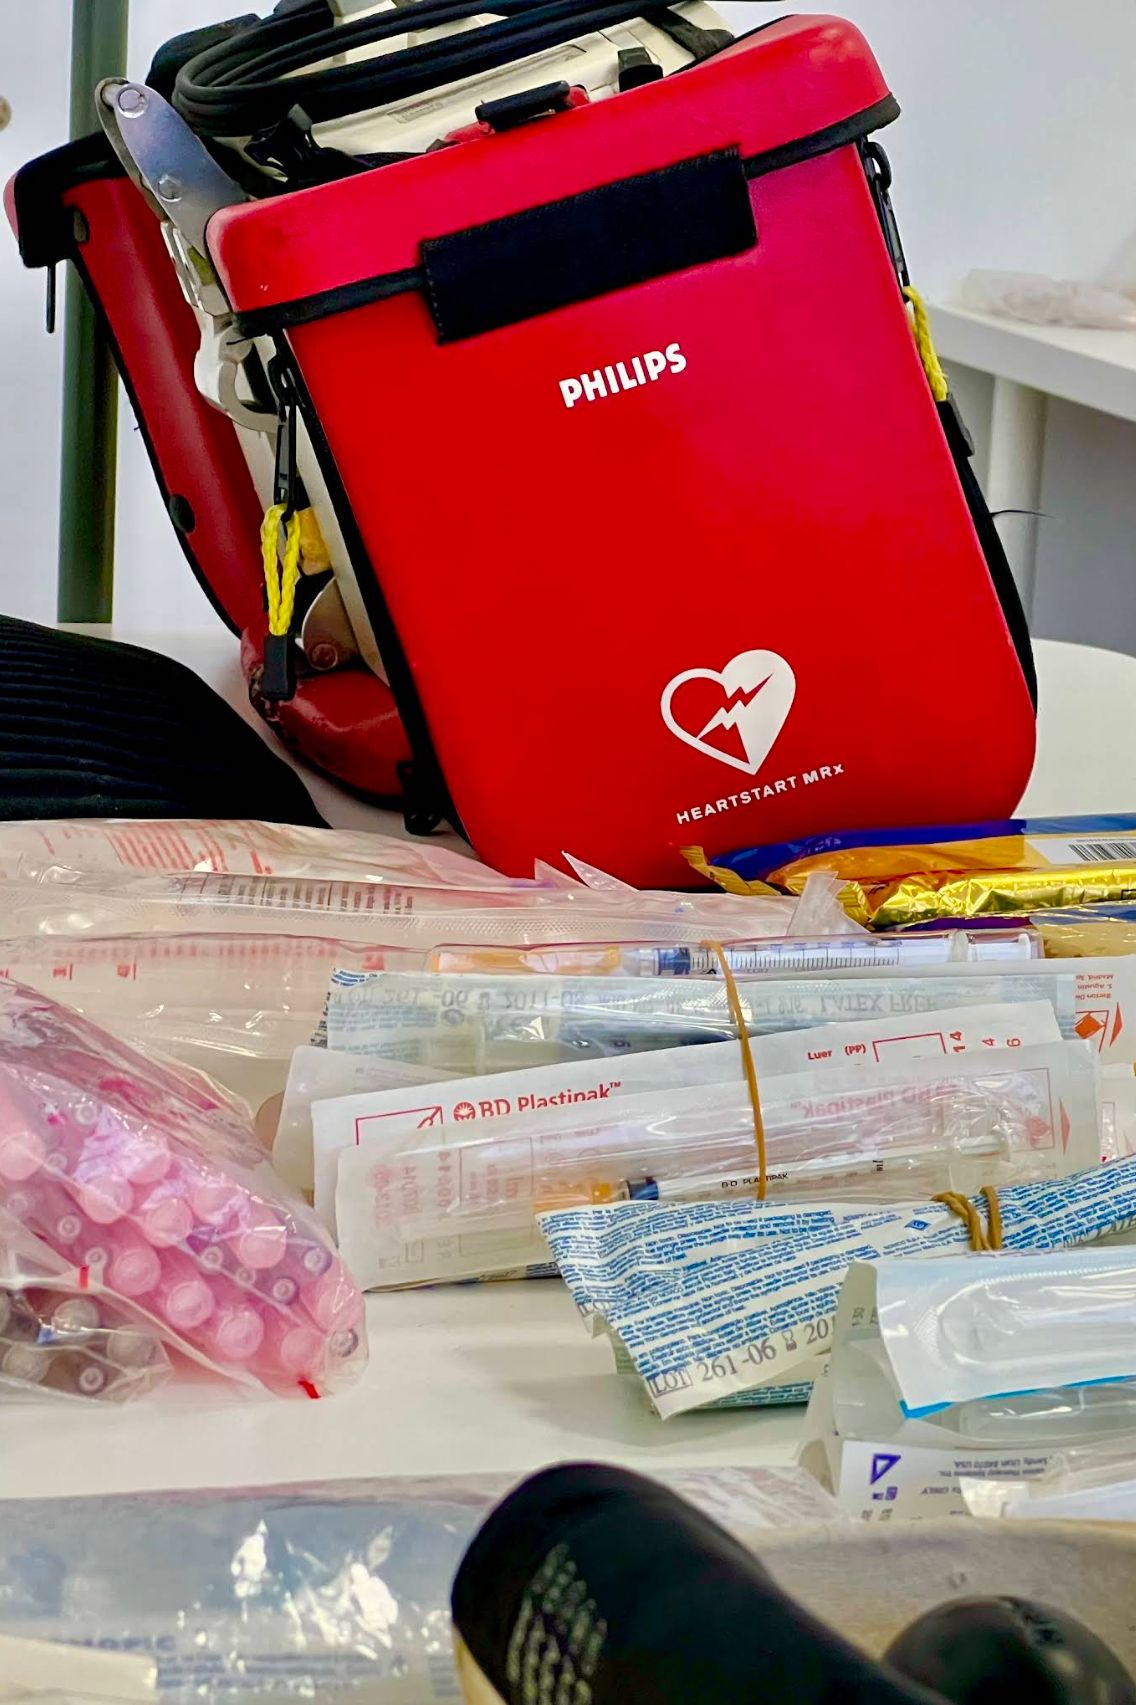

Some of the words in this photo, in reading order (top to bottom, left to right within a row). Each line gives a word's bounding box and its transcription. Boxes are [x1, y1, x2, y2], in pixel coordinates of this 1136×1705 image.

[558, 342, 688, 408] PHILIPS
[676, 776, 798, 825] HEARTSTART
[802, 763, 845, 785] MRx
[808, 1048, 833, 1061] Luer
[844, 1044, 867, 1057] (PP)
[480, 1098, 511, 1118] BD
[653, 1369, 688, 1394] LOT
[696, 1354, 738, 1383] 261
[742, 1338, 777, 1367] -06
